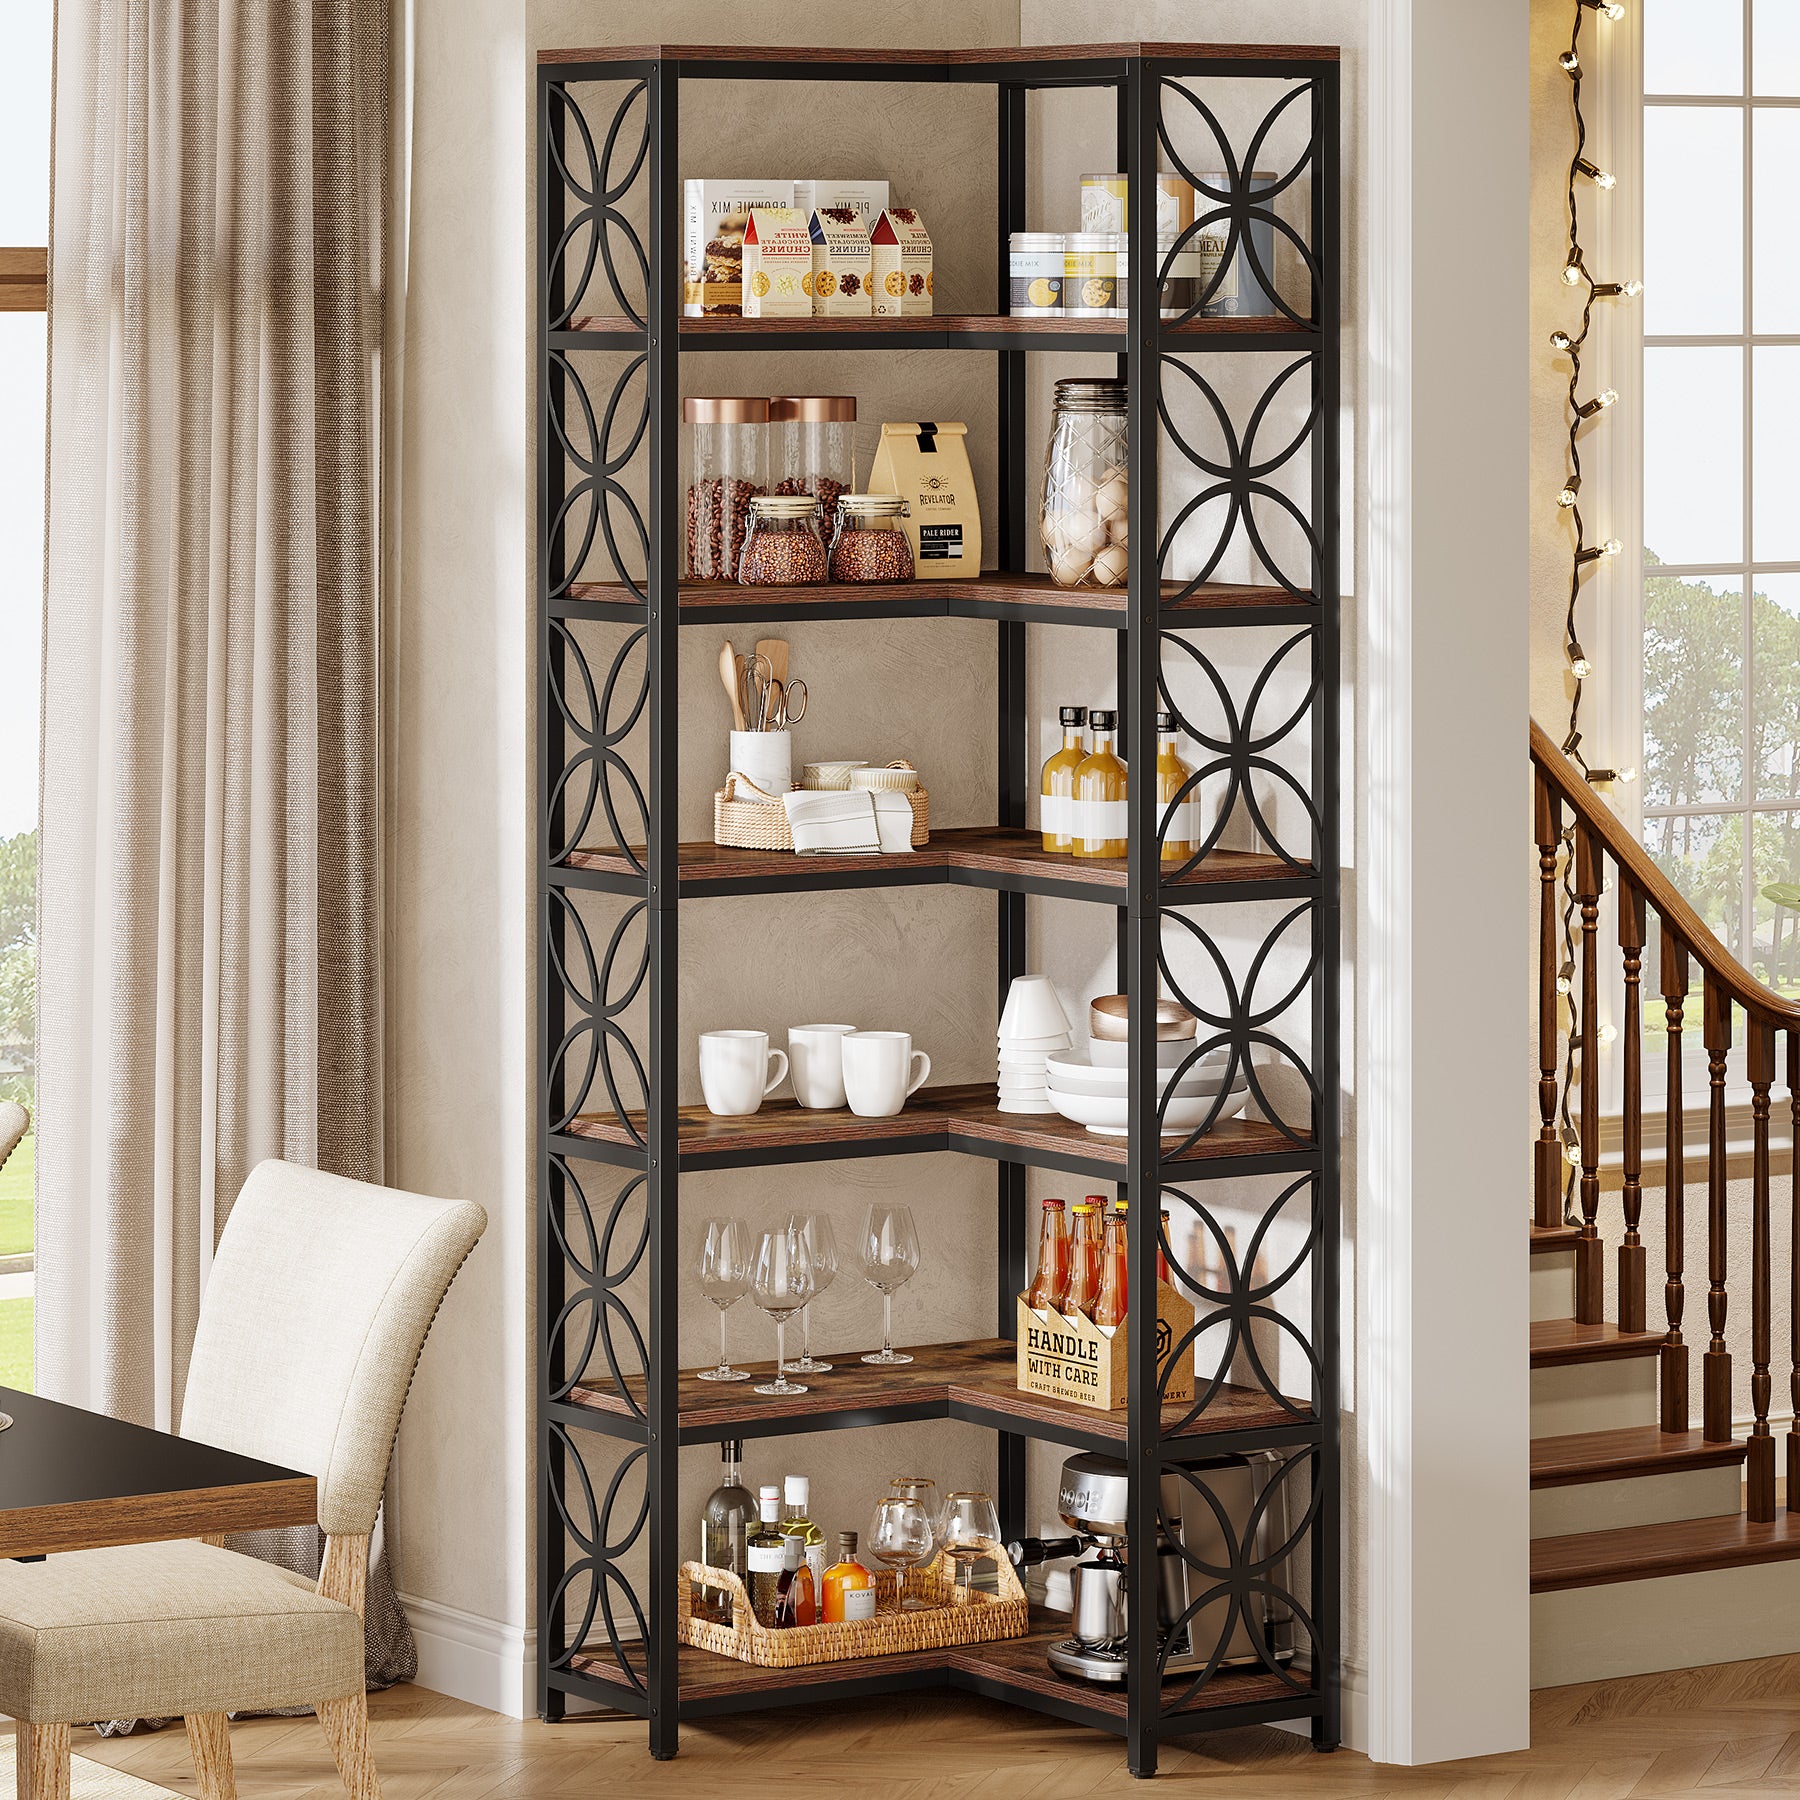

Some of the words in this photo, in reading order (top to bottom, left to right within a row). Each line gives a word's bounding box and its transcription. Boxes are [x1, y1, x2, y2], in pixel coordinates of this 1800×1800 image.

[1200, 240, 1225, 252] MEAL
[919, 494, 956, 506] REVELATOR
[923, 529, 939, 537] PALE
[1028, 1327, 1099, 1362] HANDLE
[1028, 1358, 1061, 1379] WITH
[1065, 1366, 1099, 1387] CARE
[1030, 1381, 1051, 1392] CRAFT
[1052, 1385, 1078, 1399] BREWED
[1079, 1392, 1096, 1403] BEER
[1162, 1390, 1187, 1400] WERY
